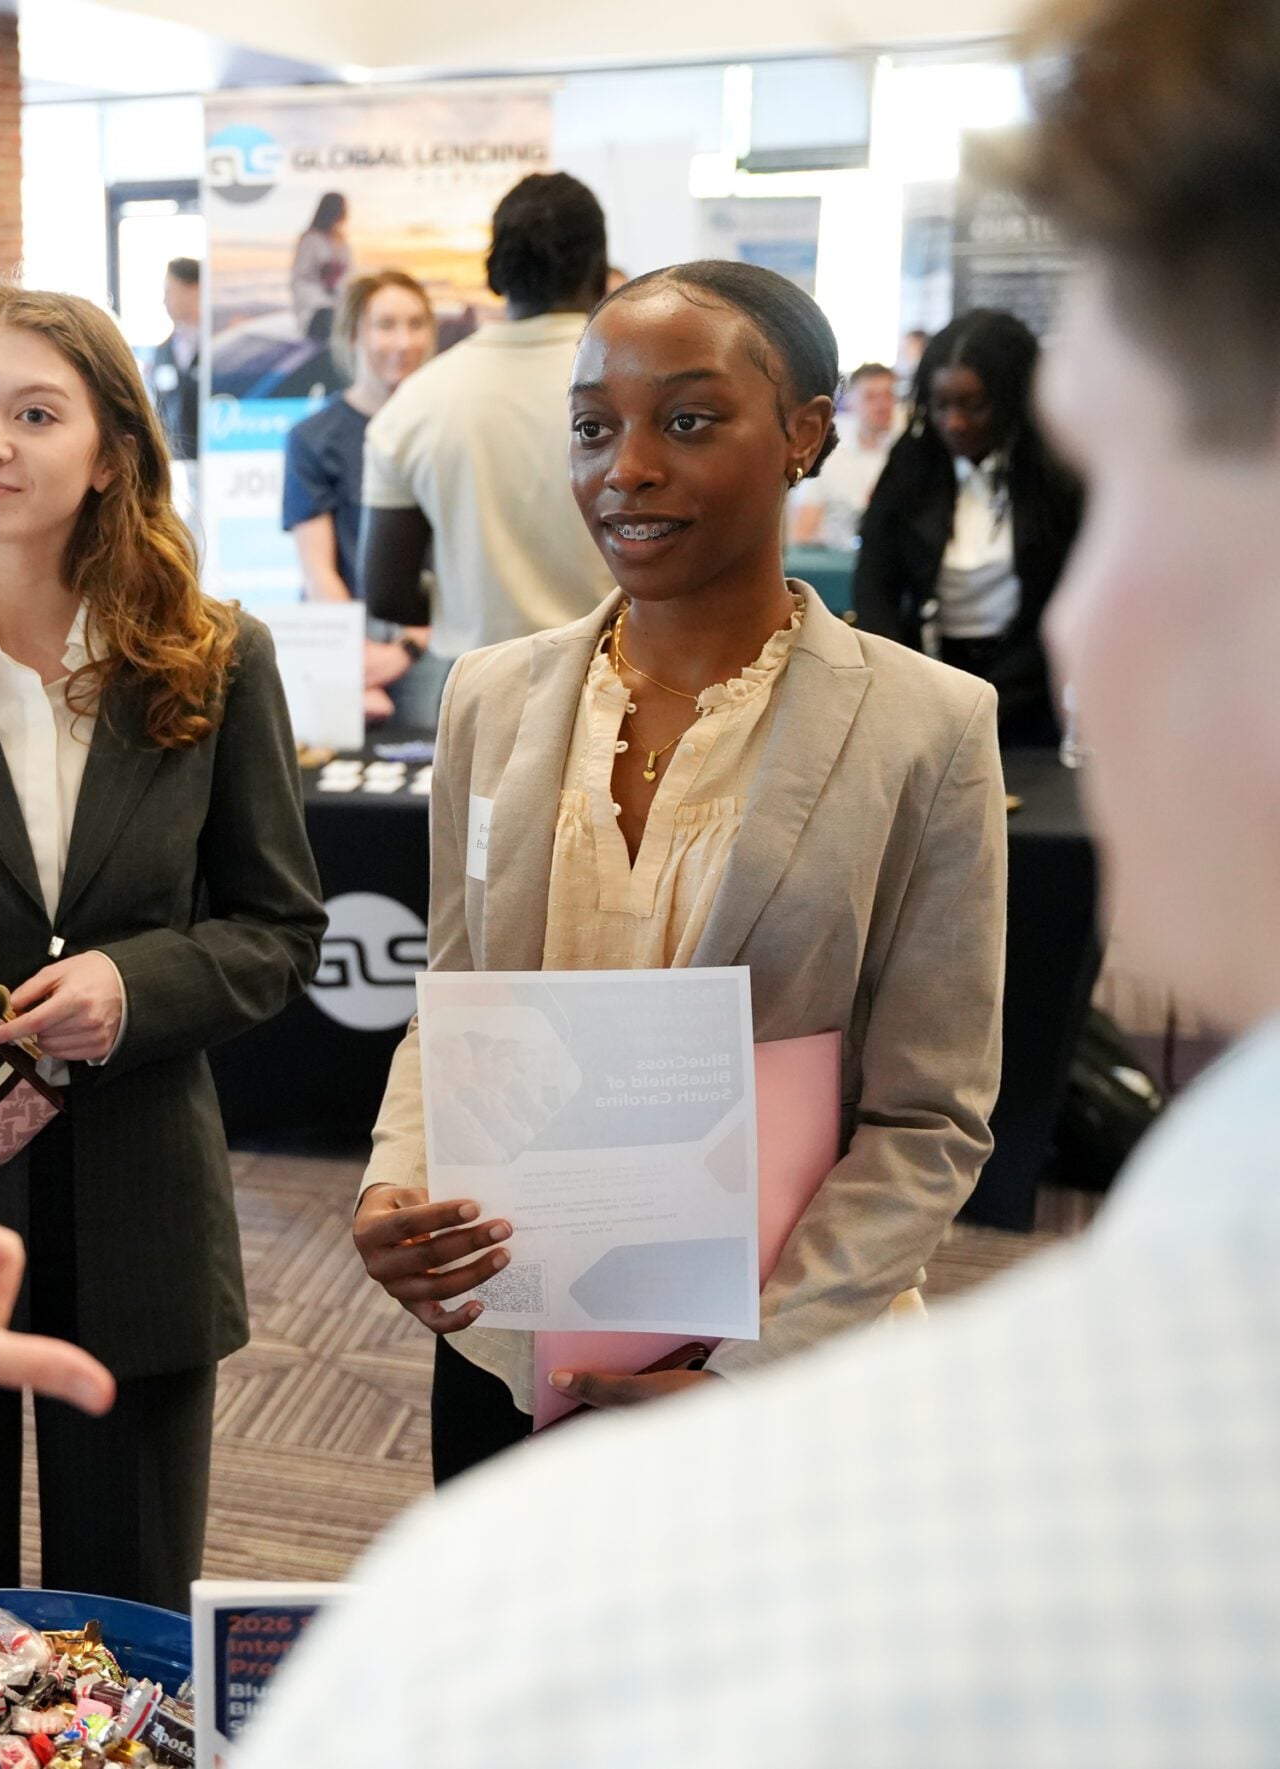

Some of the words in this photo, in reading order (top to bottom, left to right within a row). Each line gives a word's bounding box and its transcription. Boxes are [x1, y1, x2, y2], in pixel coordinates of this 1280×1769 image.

[291, 144, 407, 172] GLOBAL
[414, 140, 550, 166] LENDING
[228, 1615, 292, 1633] 2026
